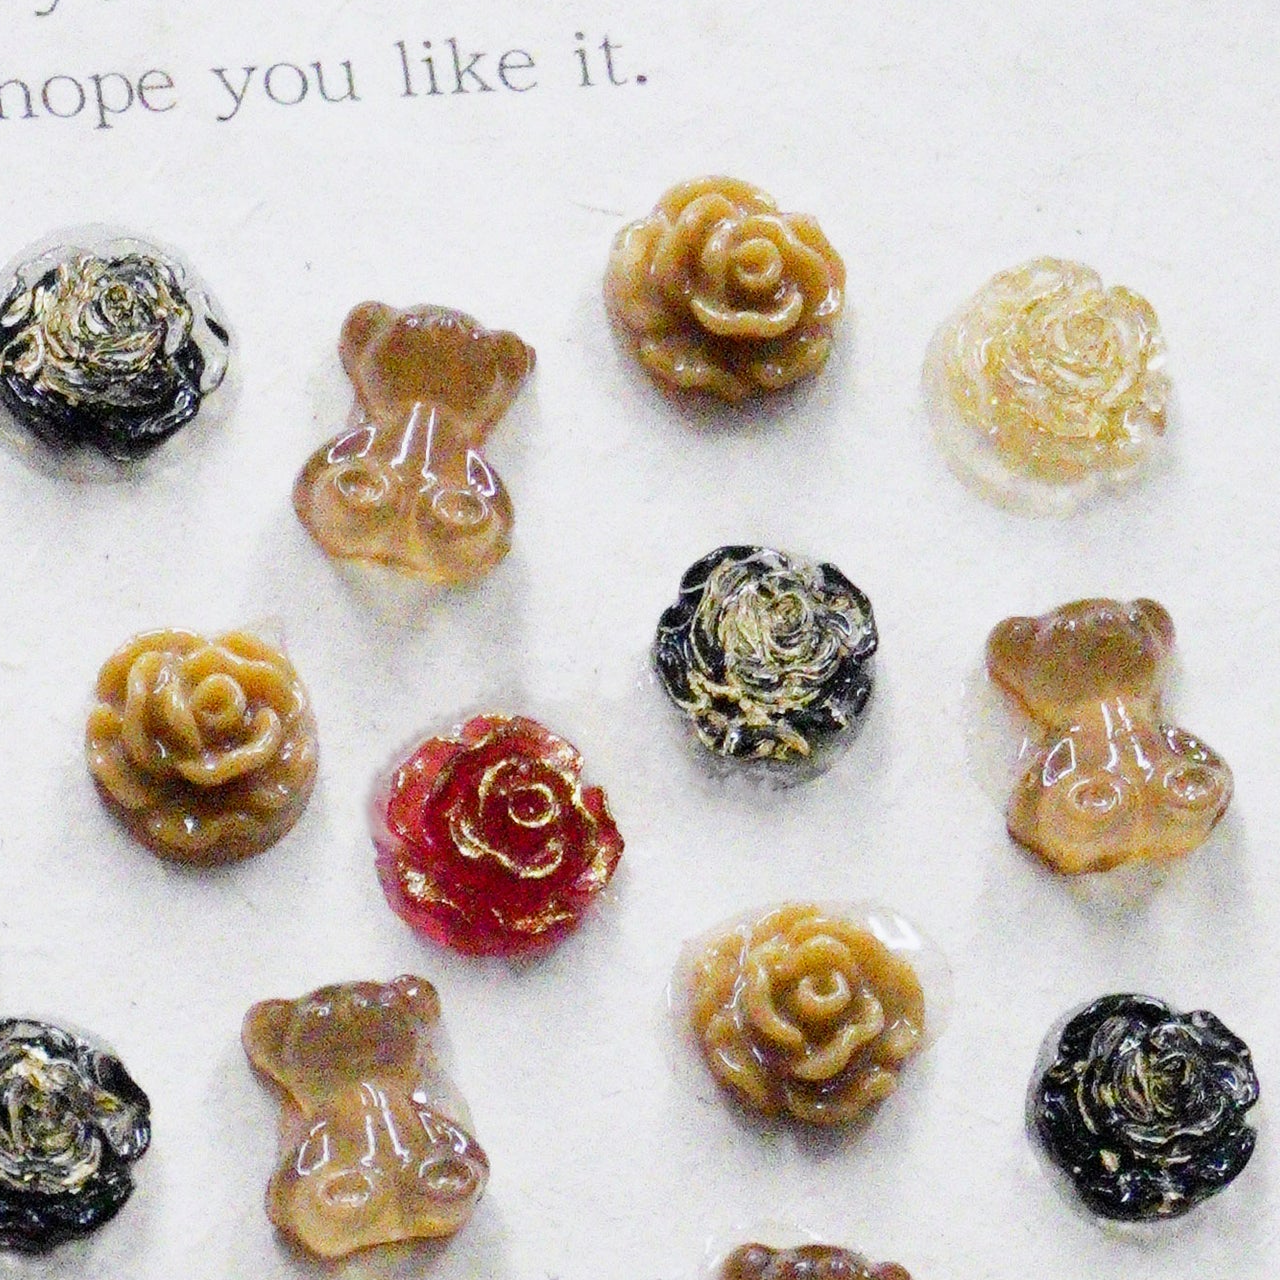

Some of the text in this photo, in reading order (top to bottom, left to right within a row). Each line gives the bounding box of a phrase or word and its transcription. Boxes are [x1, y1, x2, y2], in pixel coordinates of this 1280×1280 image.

[210, 58, 362, 123] you
[393, 37, 537, 98] like
[573, 31, 649, 87] it.
